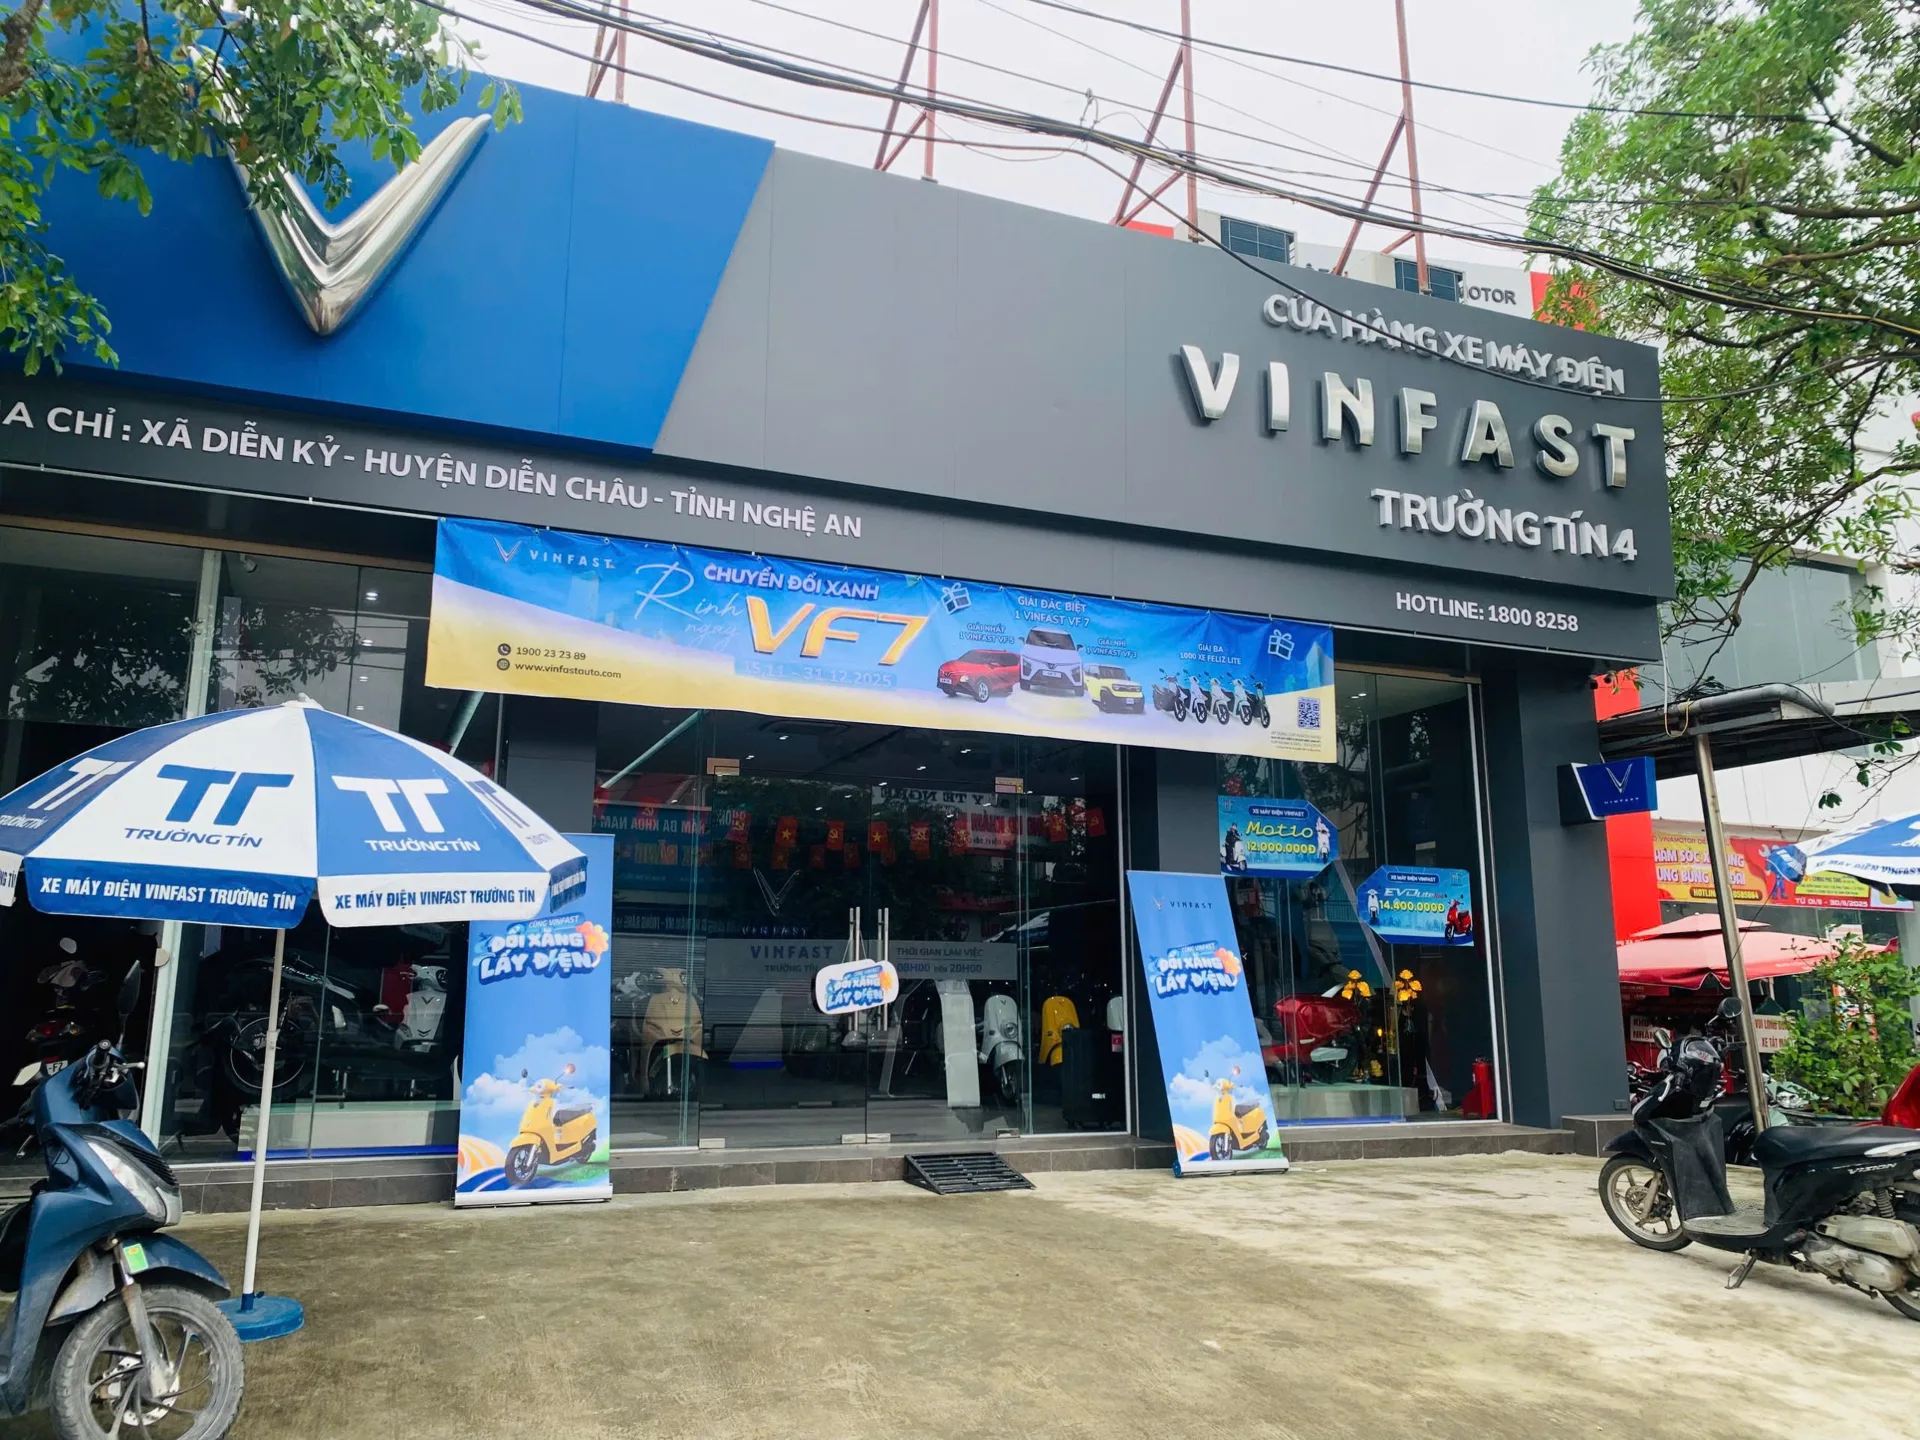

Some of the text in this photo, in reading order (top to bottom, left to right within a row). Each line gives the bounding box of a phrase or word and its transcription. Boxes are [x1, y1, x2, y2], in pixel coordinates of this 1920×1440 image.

[1342, 307, 1438, 353] HÀNG
[1439, 330, 1484, 365] XE
[1486, 342, 1553, 379] MÁY
[1180, 344, 1635, 488] VINFAST
[139, 417, 193, 449] XÃ
[202, 420, 284, 461] DIỄN
[364, 449, 477, 489] HUYỆN
[485, 459, 557, 497] DIỄN
[565, 476, 648, 509] CHÂU
[670, 485, 736, 522] TỈNH
[742, 500, 816, 536] NGHỆ
[823, 510, 862, 538] AN
[1371, 488, 1541, 547] TRƯỜNG
[1543, 510, 1609, 557] TÍN
[530, 549, 613, 569] VINFAST
[703, 563, 880, 600] CHUYỂN ĐỔI XANH
[1017, 595, 1087, 615] GIẢI ĐẶC BIỆT
[1396, 592, 1579, 632] HOTLINE: 1800 8258
[1015, 610, 1091, 628] 1 VINFAST VF 7
[965, 632, 997, 644] VINFAST
[998, 635, 1009, 644] VF
[516, 646, 586, 661] 1900 23 23 89
[1092, 647, 1122, 658] VINFAST
[1123, 650, 1133, 659] VF
[1180, 651, 1242, 665] 1000 XE FELIZ LITE
[1213, 645, 1224, 653] BA
[514, 661, 622, 679] www.vinfastauto.com
[803, 666, 892, 687] 31.12.2025
[1245, 821, 1314, 838] Motio
[40, 877, 297, 911] XE MÁY ĐIỆN VINFAST TRƯỜNG TÍN
[335, 886, 536, 909] XE MÁY ĐIỆN VINFAST TRƯỜNG TÍN
[1693, 888, 1717, 898] HOTLIN
[1169, 900, 1213, 909] VINFAST
[548, 915, 580, 927] VINFAST
[527, 927, 584, 949] XĂNG
[751, 944, 834, 960] VINFAST
[920, 947, 942, 957] GIAN
[963, 946, 984, 958] VIỆC
[480, 949, 529, 980] LẤY
[949, 963, 982, 974] 20H00
[1847, 1162, 1898, 1175] VISION
